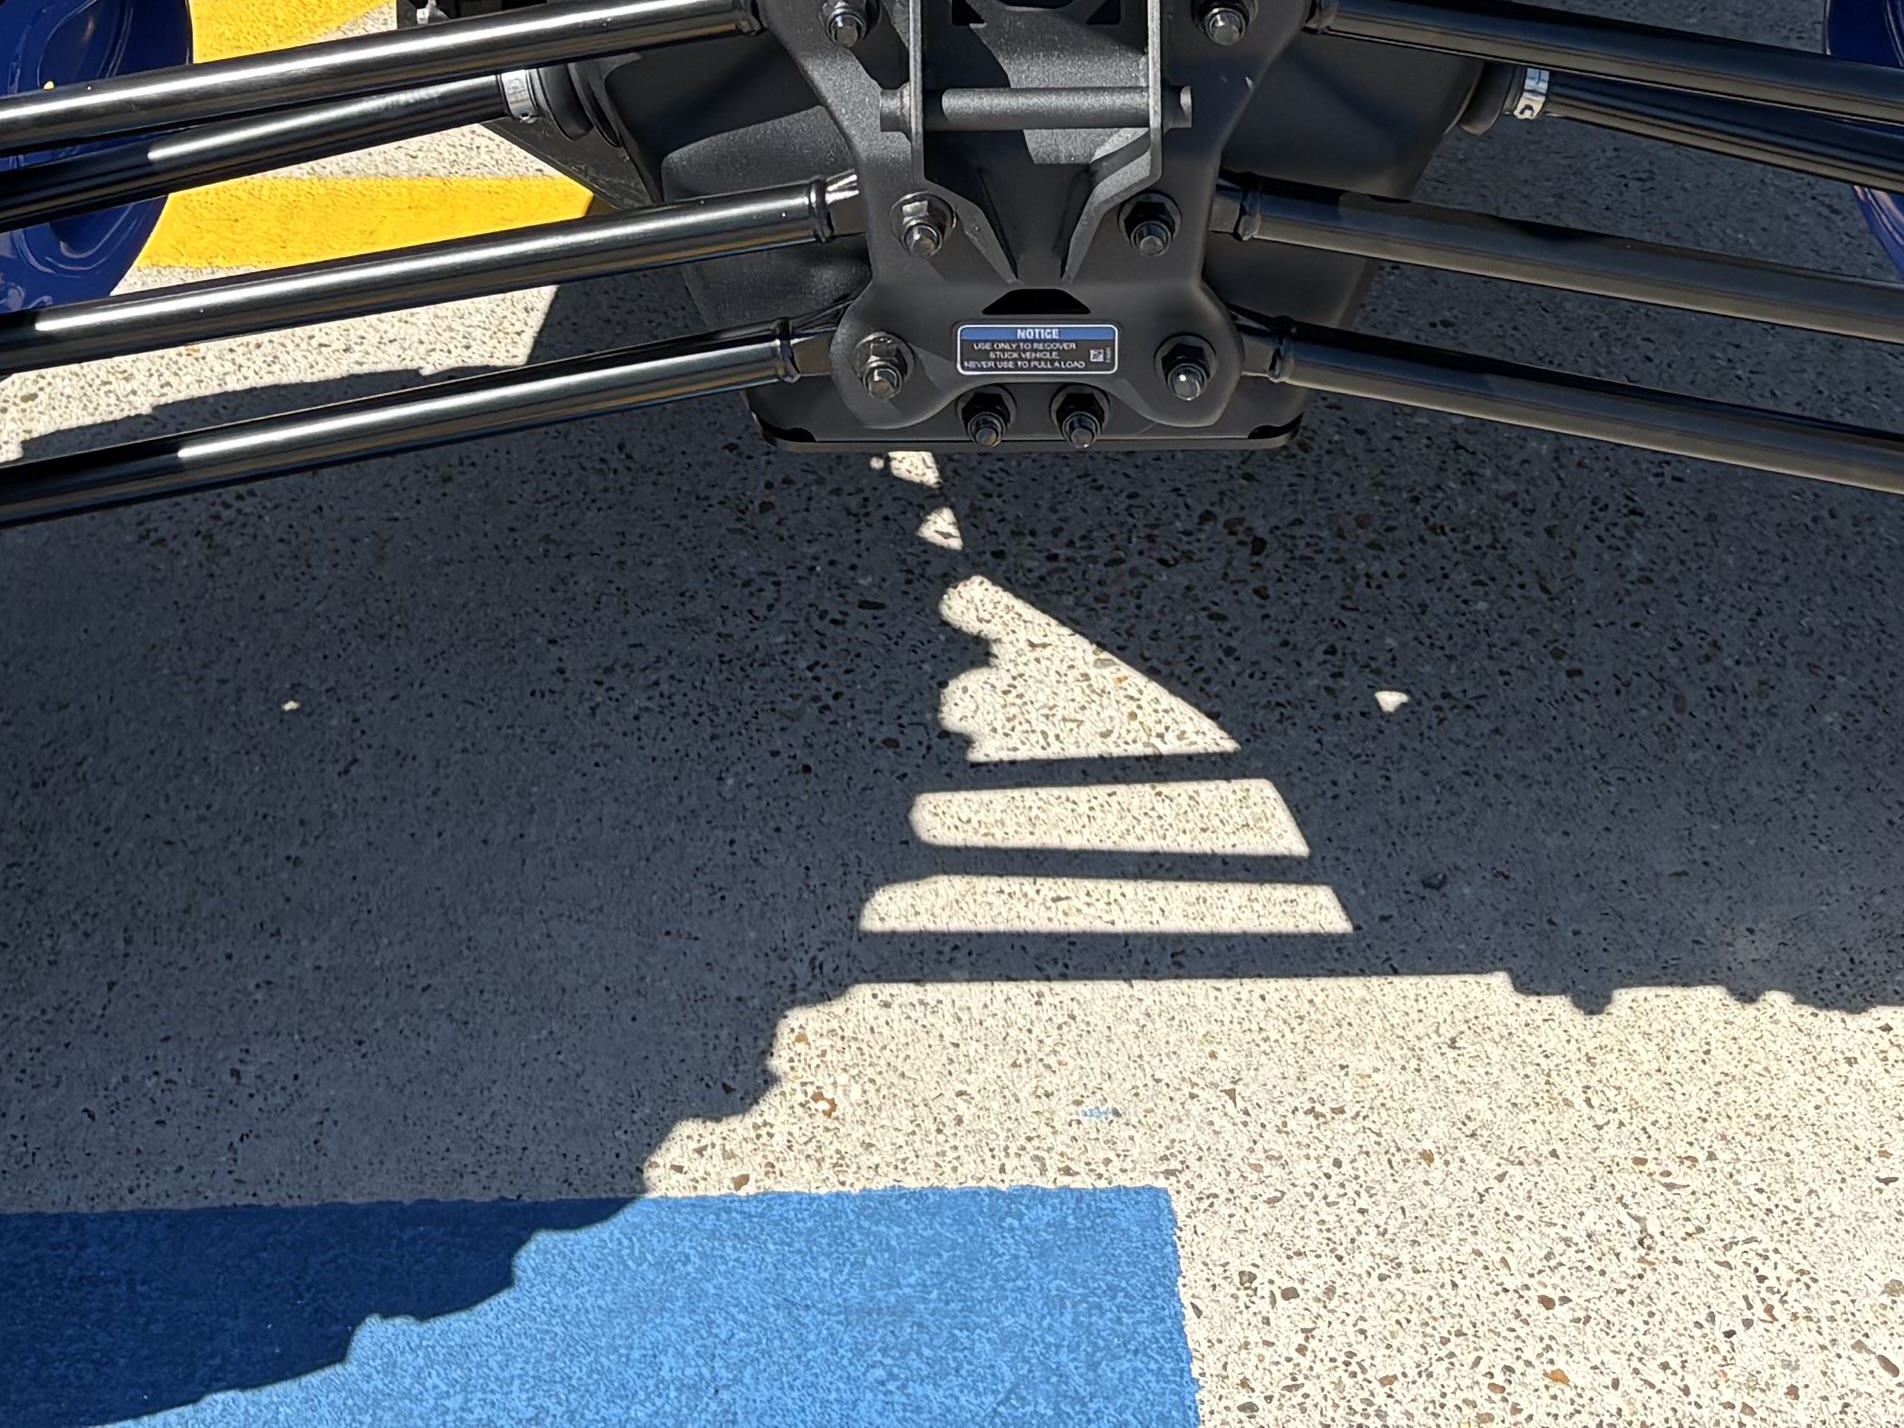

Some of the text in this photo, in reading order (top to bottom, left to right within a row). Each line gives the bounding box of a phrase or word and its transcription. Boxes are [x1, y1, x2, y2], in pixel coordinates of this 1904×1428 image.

[1016, 328, 1060, 340] NOTICE
[973, 342, 1077, 350] USE ONLY TO RECOVER
[989, 351, 1019, 360] STUCK
[964, 360, 996, 369] NEVER
[997, 360, 1015, 369] USE
[1017, 360, 1029, 369] TO
[1030, 360, 1054, 369] PULL
[1054, 360, 1061, 369] A
